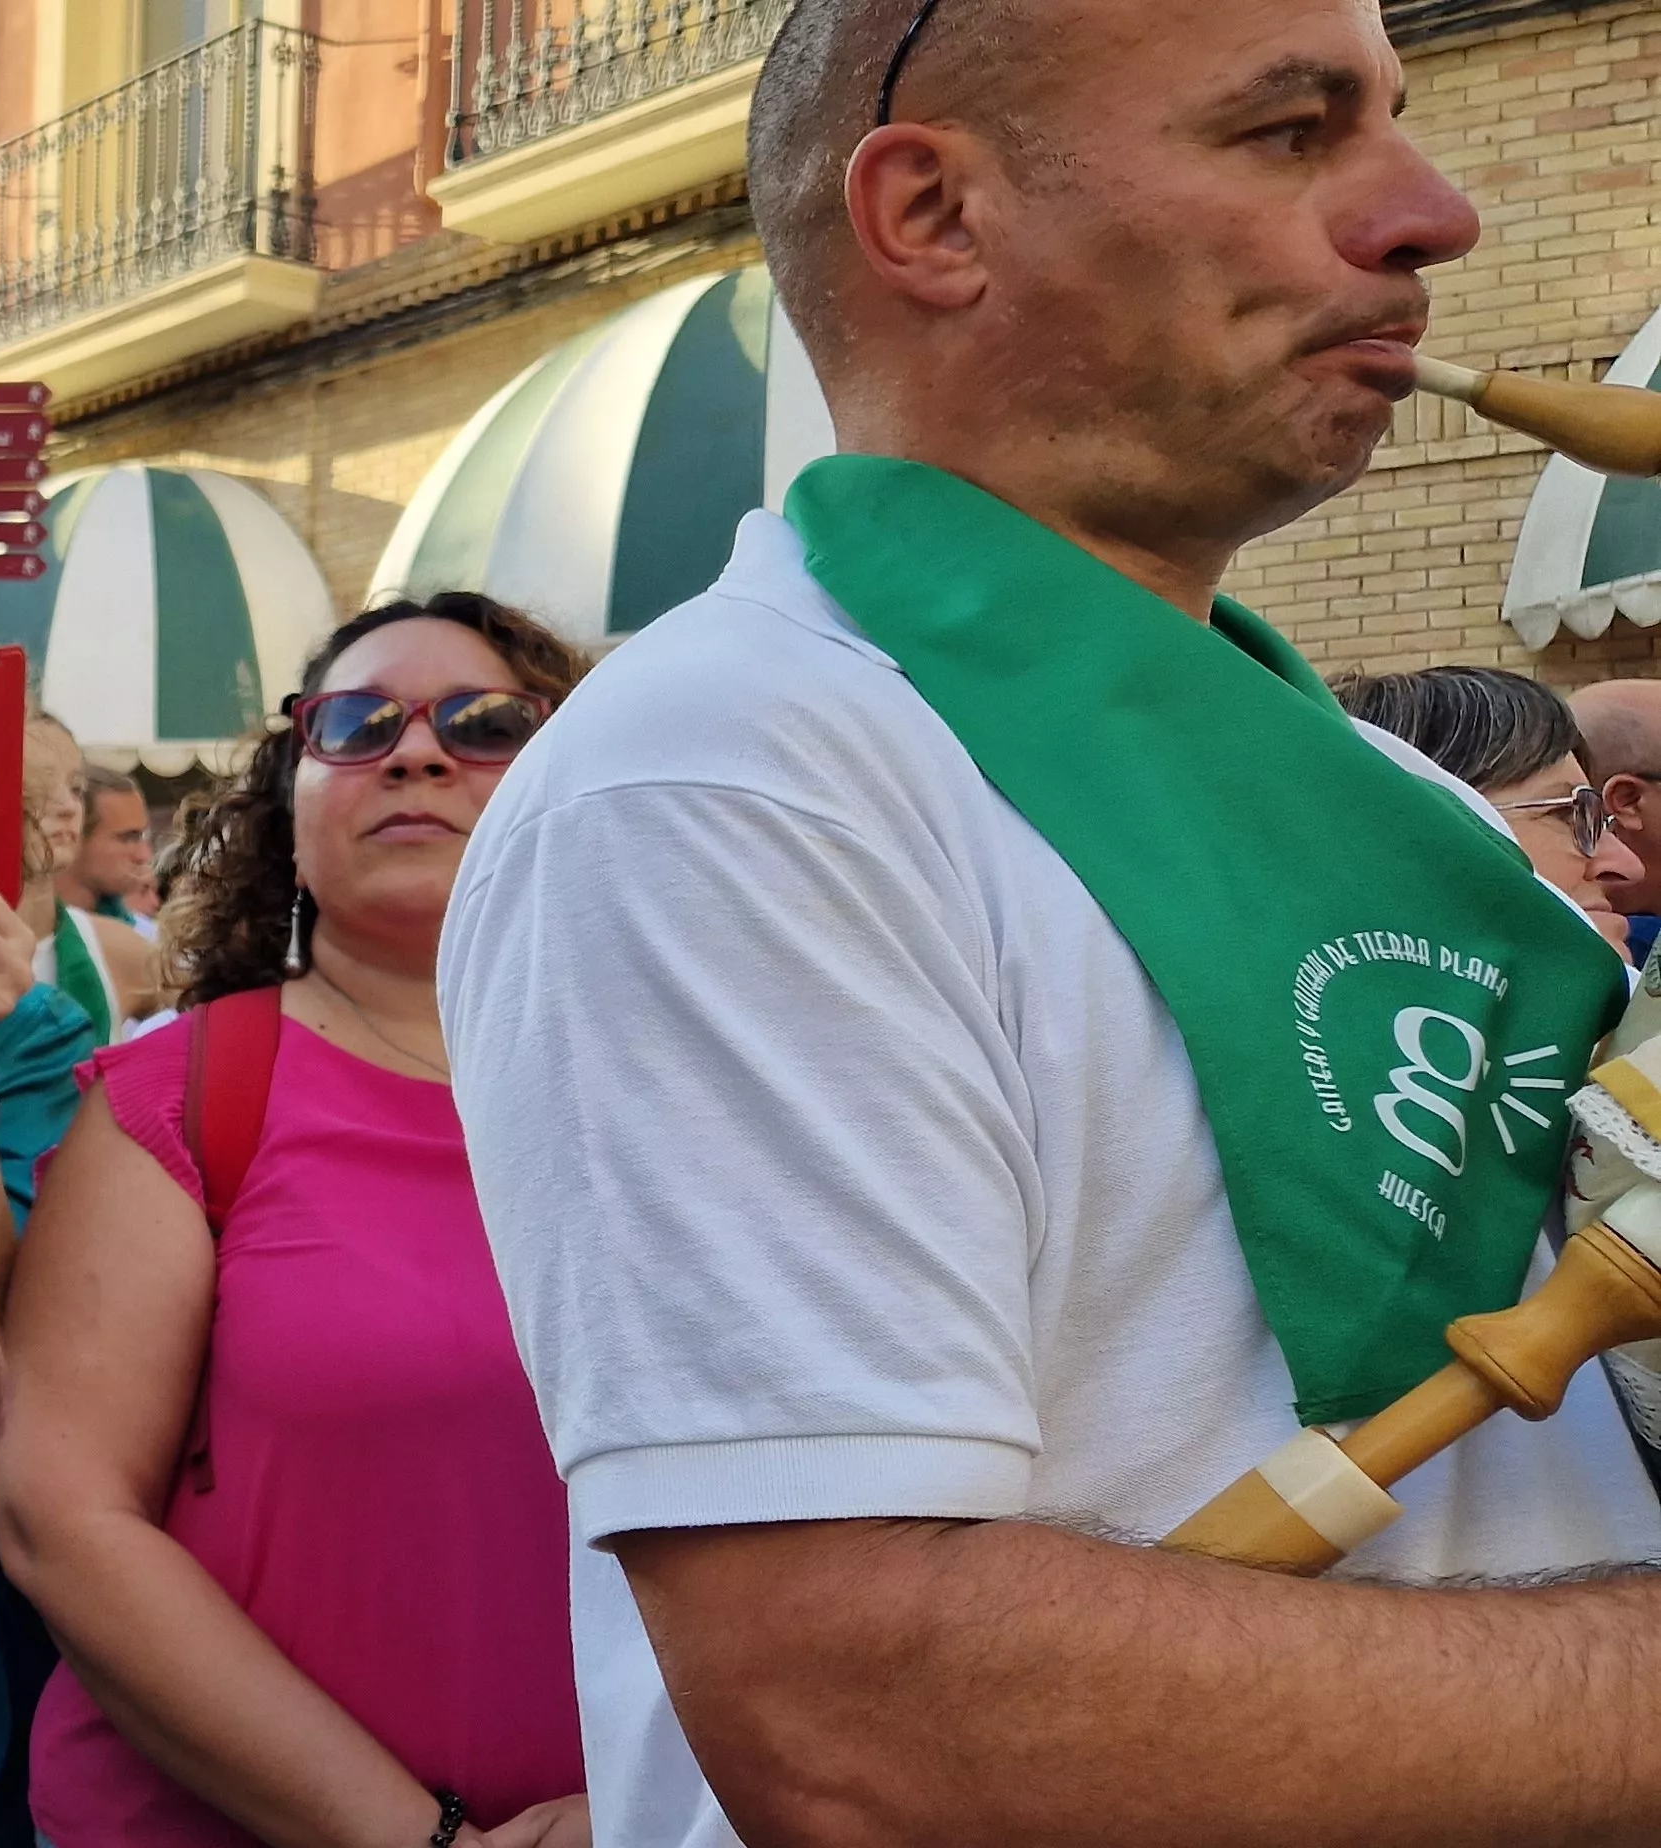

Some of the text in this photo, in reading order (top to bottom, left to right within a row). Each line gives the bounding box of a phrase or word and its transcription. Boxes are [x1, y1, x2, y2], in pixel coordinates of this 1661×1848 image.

[1321, 936, 1358, 970] DE
[1352, 930, 1431, 966] TIERRA
[1440, 945, 1508, 1002] PLANA
[1299, 1039, 1353, 1132] GAITERS
[1377, 1169, 1447, 1242] HUESCA
